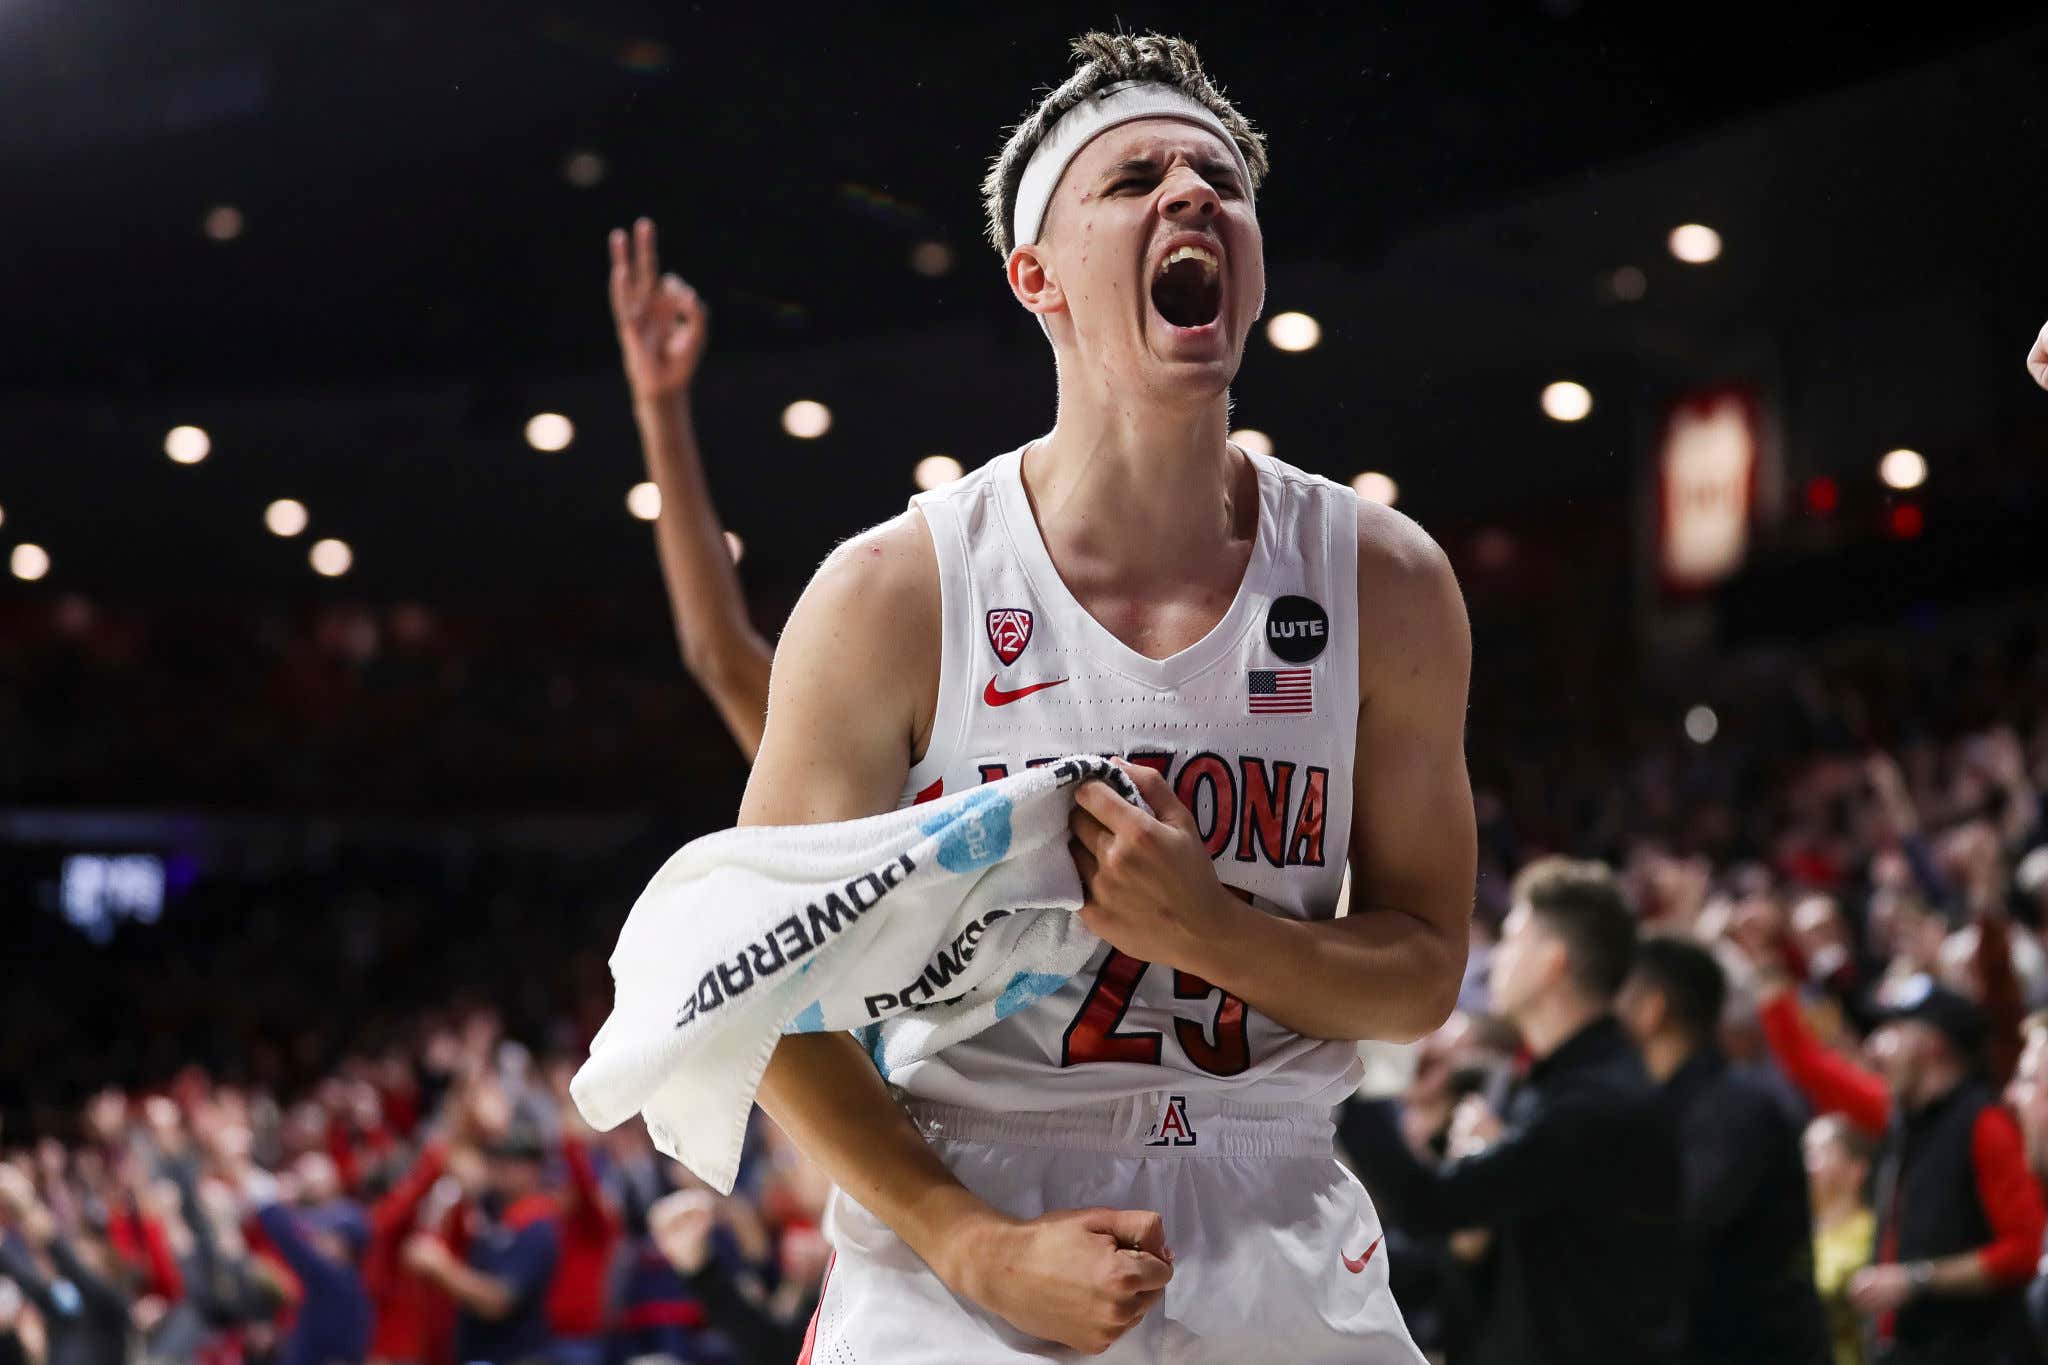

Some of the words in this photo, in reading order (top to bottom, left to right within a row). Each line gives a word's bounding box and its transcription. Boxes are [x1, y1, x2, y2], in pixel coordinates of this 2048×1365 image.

[989, 611, 1030, 642] PAC
[998, 631, 1019, 652] 12
[1271, 620, 1324, 638] LUTE
[676, 853, 916, 1028] POWERADE
[1062, 884, 1254, 1077] 25
[1144, 1096, 1197, 1146] A
